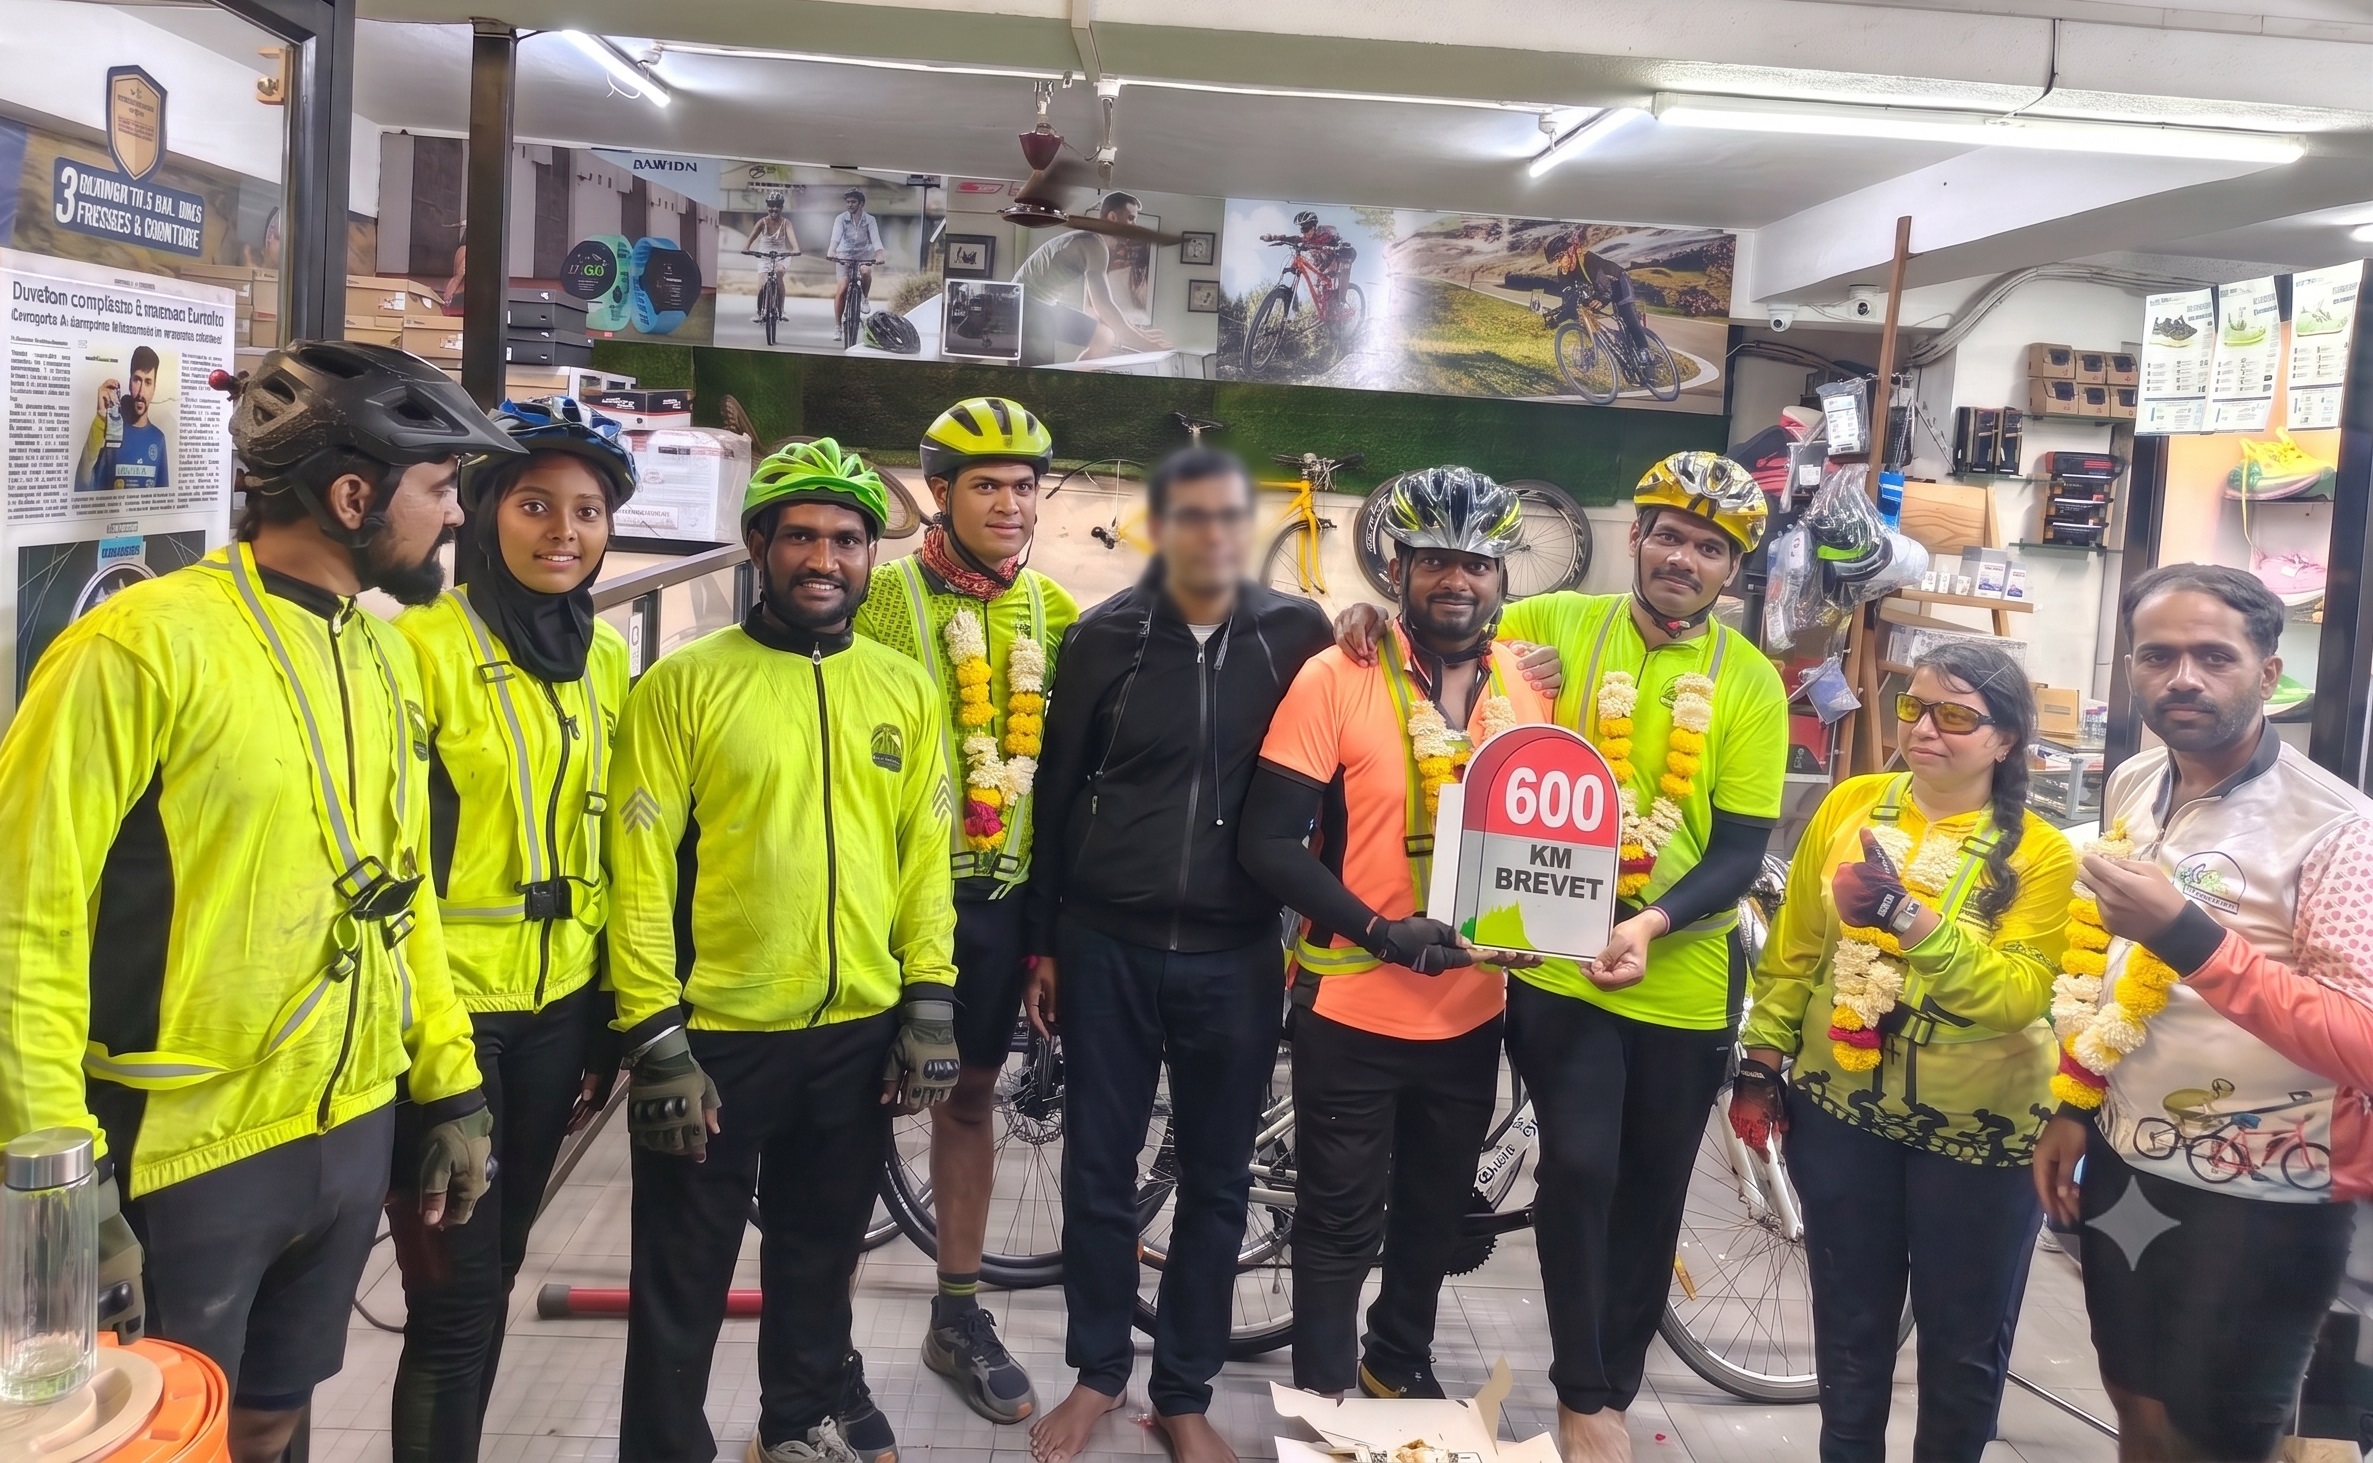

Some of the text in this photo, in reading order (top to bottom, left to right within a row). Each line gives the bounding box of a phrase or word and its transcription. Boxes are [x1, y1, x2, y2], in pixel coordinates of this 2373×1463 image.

[56, 166, 78, 223] 3
[1505, 766, 1605, 833] 600
[1530, 844, 1572, 870] KM
[1495, 867, 1603, 900] BREVET
